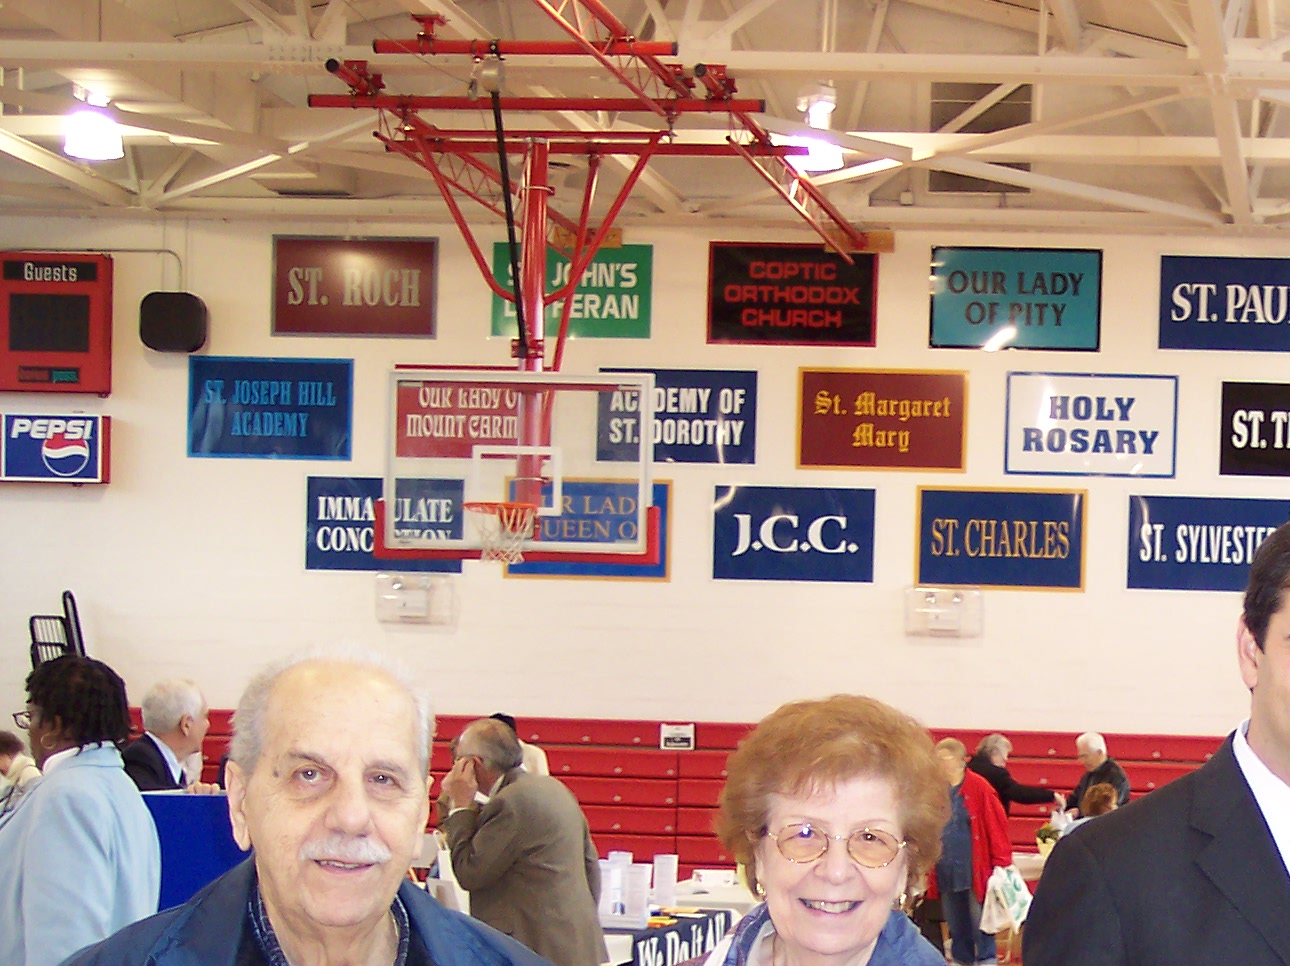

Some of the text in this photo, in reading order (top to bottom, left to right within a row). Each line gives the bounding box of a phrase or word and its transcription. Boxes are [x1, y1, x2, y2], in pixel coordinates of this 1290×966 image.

[24, 262, 77, 282] Guests
[748, 260, 837, 282] COPTIC
[947, 270, 1085, 297] OUR LADY
[287, 266, 421, 308] ST. ROCH
[723, 284, 862, 306] ORTHODOX
[964, 301, 1068, 327] OF PITY
[1171, 282, 1217, 323] ST.
[741, 309, 843, 329] CHURCH
[204, 380, 336, 406] ST. JOSEPH HILL
[458, 388, 501, 410] LADY
[505, 388, 518, 410] O
[609, 387, 746, 414] ACDEMY OF
[813, 389, 952, 422] St. Margaret
[1049, 395, 1136, 422] HOLY
[11, 419, 93, 439] PEPSI
[231, 411, 309, 437] ACADEMY
[406, 414, 518, 439] MOUNT CARM
[609, 418, 744, 446] ST. DOROTHY
[852, 422, 910, 453] Mary
[1231, 409, 1268, 450] ST.
[1022, 427, 1160, 456] ROSARY
[317, 496, 453, 523] IMMALATE
[584, 495, 637, 515] LAD
[541, 520, 637, 539] UEEN O
[731, 513, 859, 557] J.C.C.
[931, 518, 1070, 560] ST. CHARLES
[1139, 523, 1278, 565] ST. SYLVESTE
